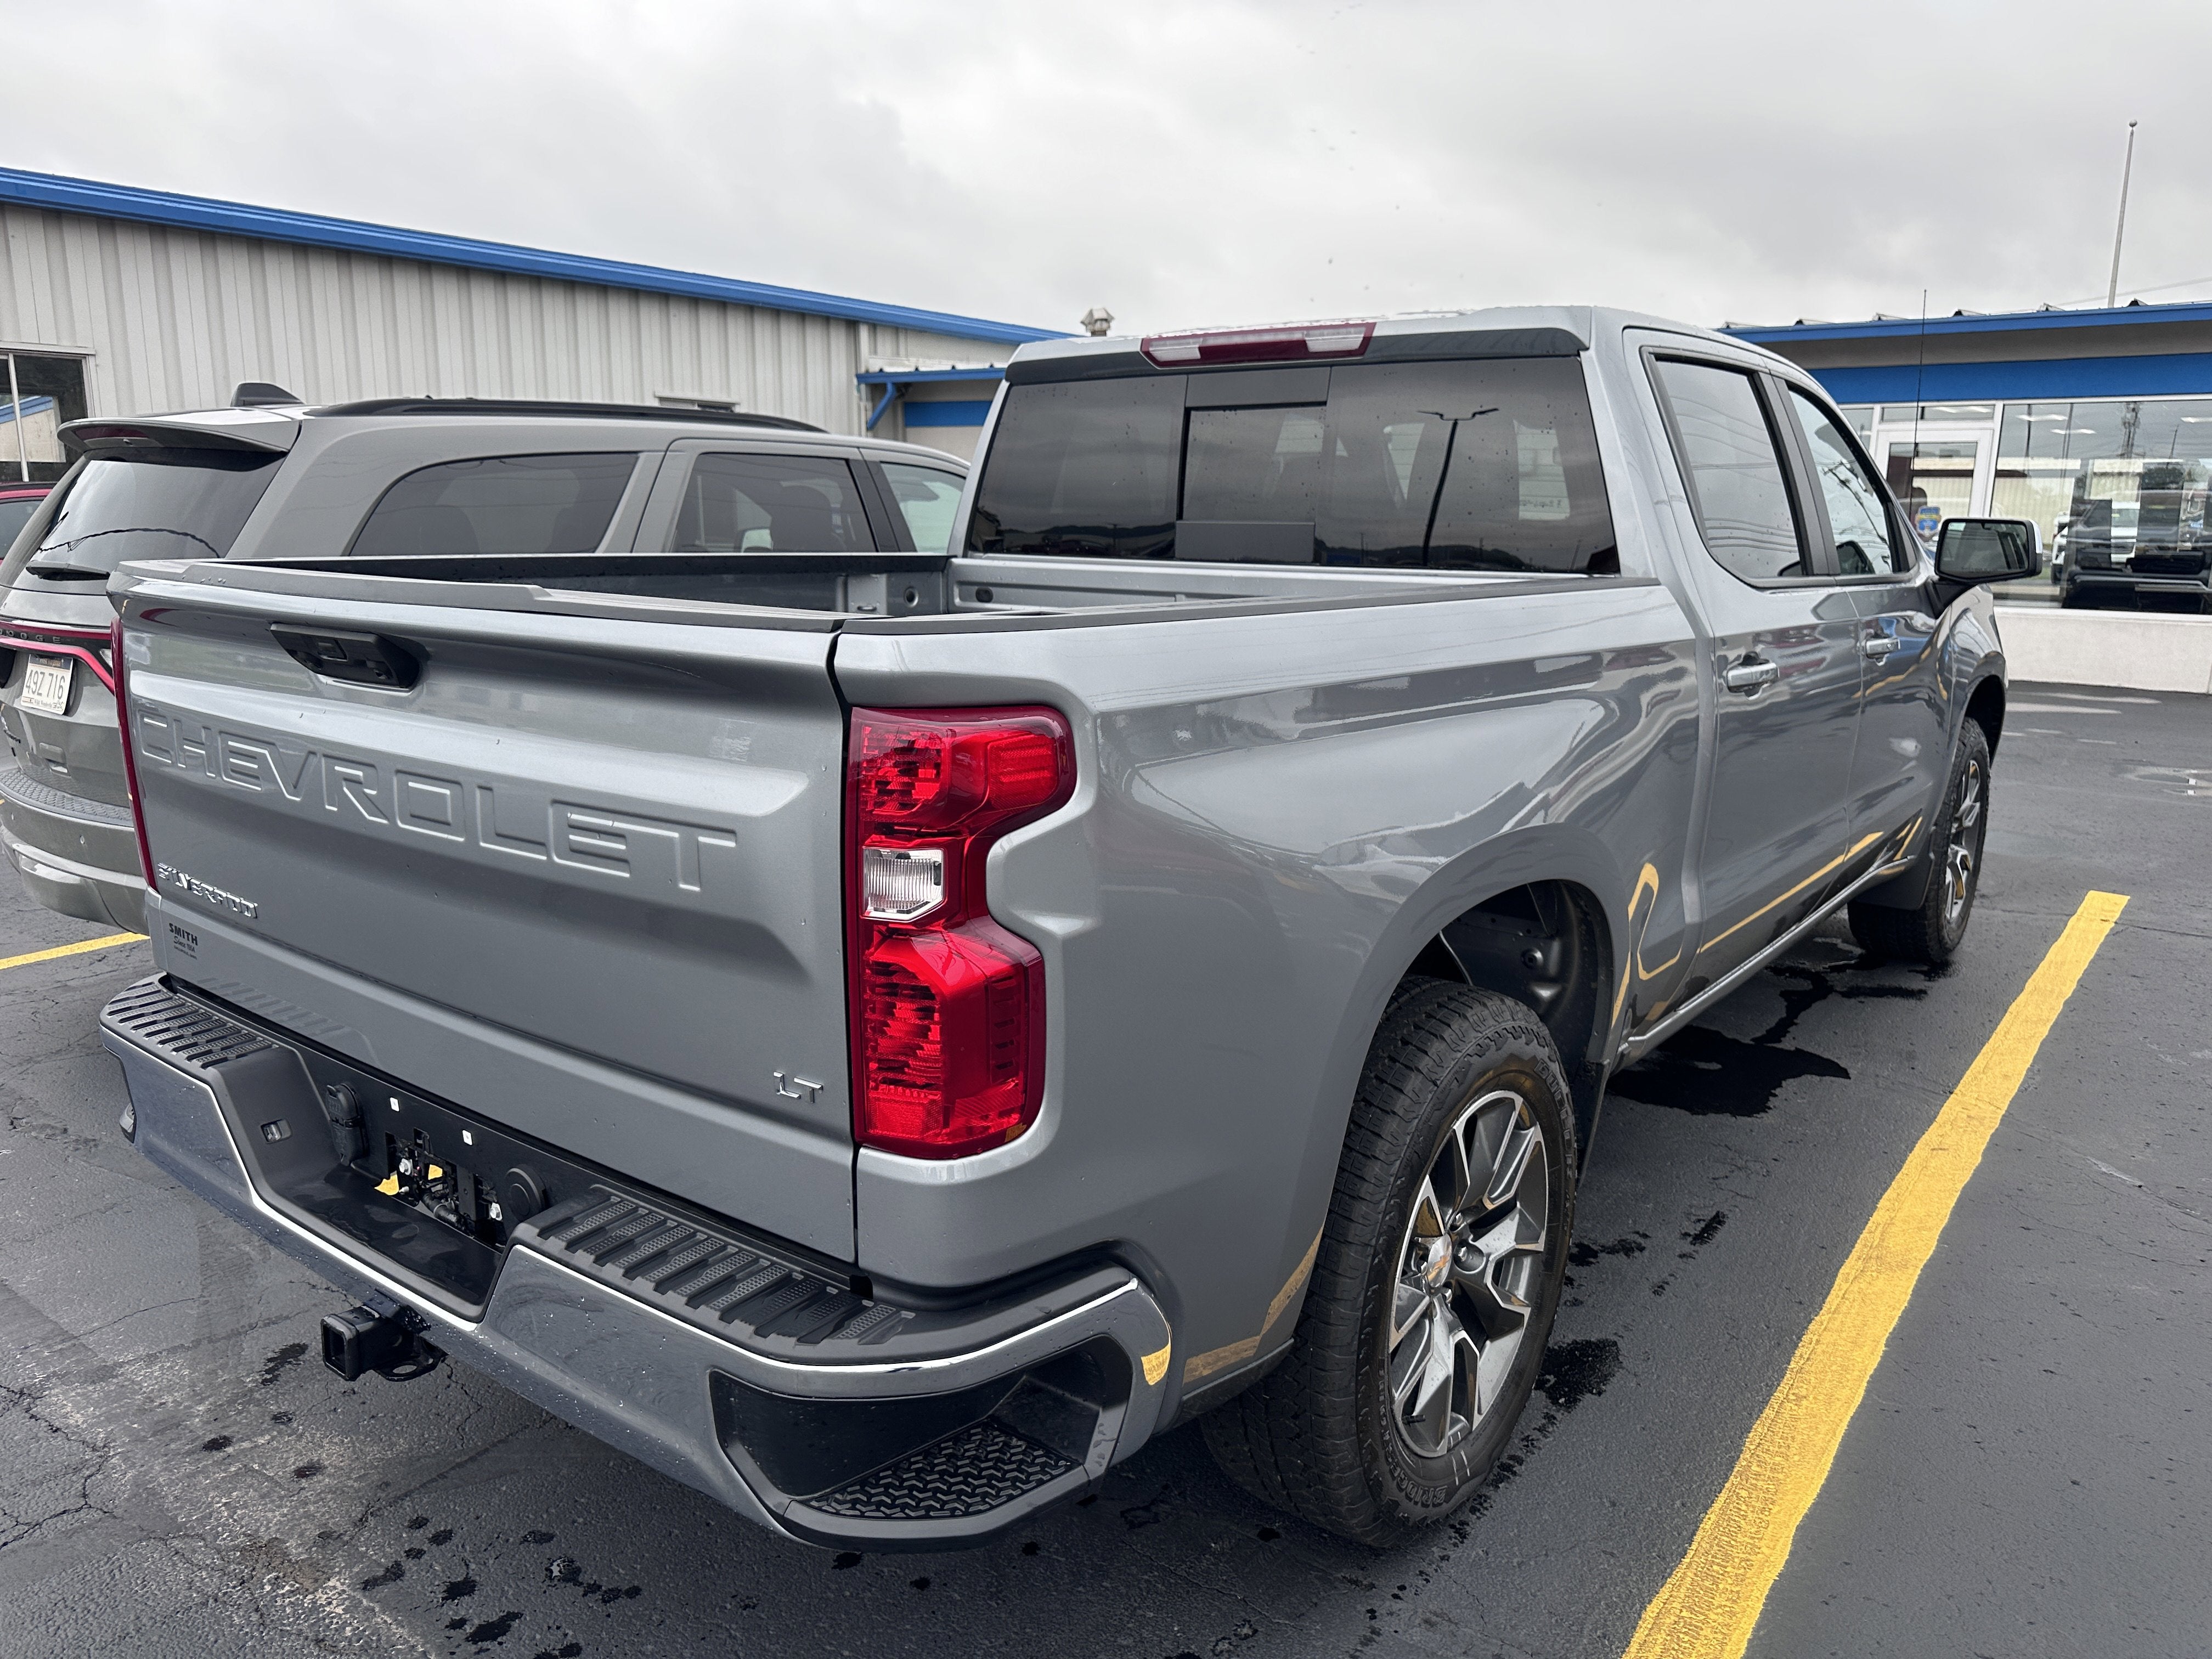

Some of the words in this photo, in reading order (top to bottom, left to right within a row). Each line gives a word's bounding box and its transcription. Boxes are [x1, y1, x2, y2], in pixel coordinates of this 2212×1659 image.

[25, 669, 46, 697] 49Z
[47, 673, 65, 699] 716
[138, 710, 737, 893] CHEVROLET
[169, 923, 198, 946] SMITH
[772, 1071, 823, 1104] LT
